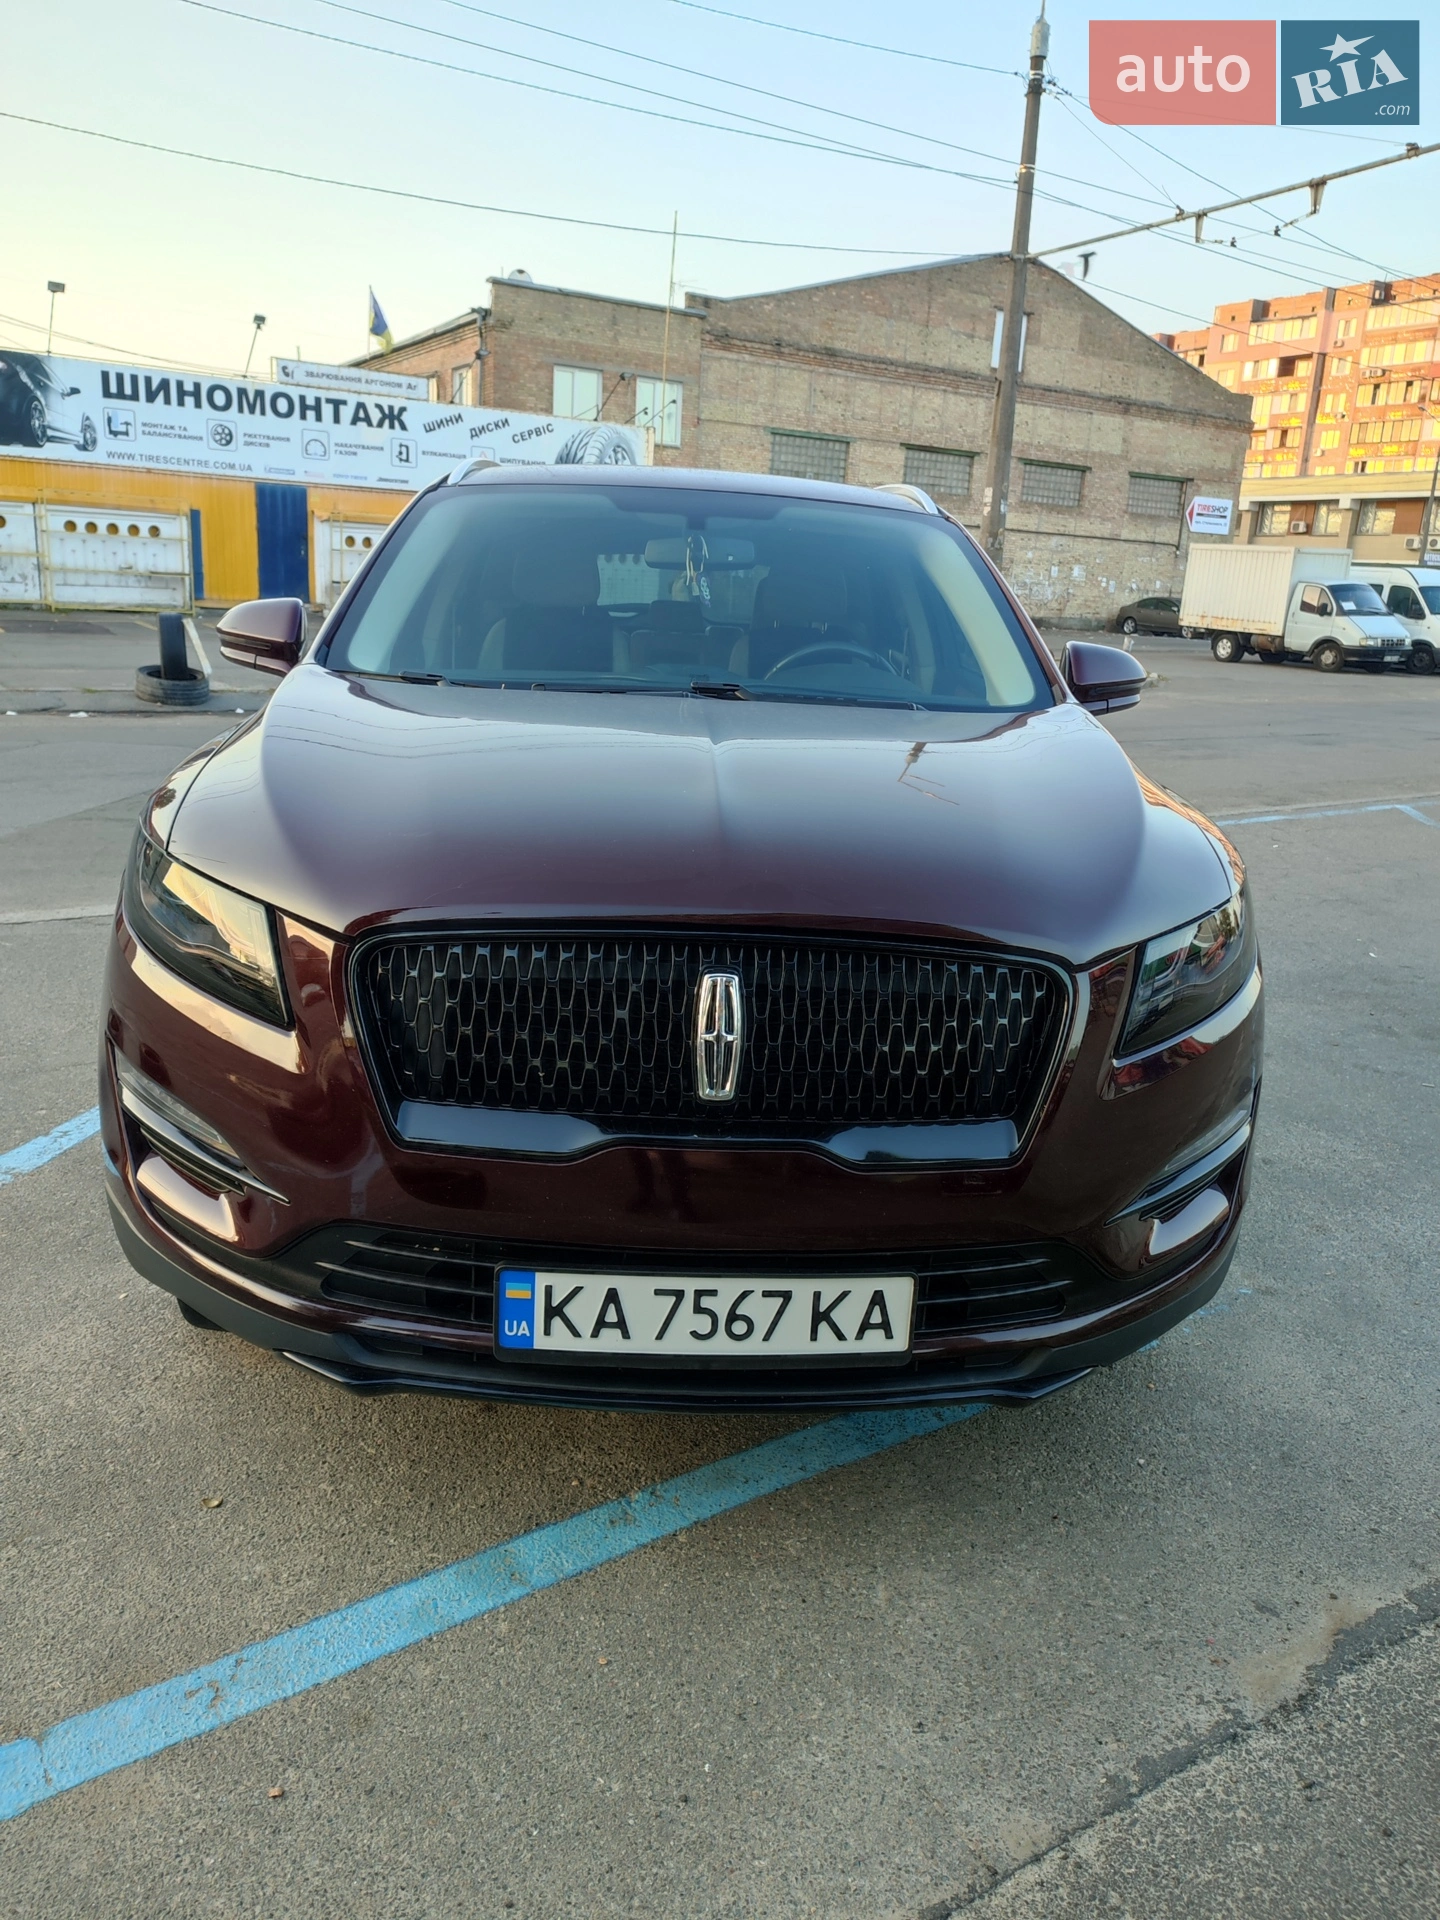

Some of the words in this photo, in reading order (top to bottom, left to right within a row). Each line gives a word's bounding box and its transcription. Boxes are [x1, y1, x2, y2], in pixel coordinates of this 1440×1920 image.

[303, 370, 363, 384] ЗВАРЮВАННЯ
[364, 378, 403, 389] АРГОНОМ
[100, 369, 408, 432] ШИНОМОНТАЖ
[141, 421, 176, 432] МОНТАЖ
[423, 412, 464, 433] ШИНИ
[469, 417, 511, 440] ДИСКИ
[141, 430, 204, 442] БАЛАНСУВАННЯ
[512, 423, 555, 444] СЕРВІС
[106, 450, 253, 473] WWW.TIRESCENTRE.COM.UA
[334, 449, 358, 457] ГАЗОМ
[543, 1285, 631, 1340] KA
[653, 1289, 793, 1341] 7567
[809, 1290, 894, 1341] KA
[504, 1319, 530, 1337] UA
